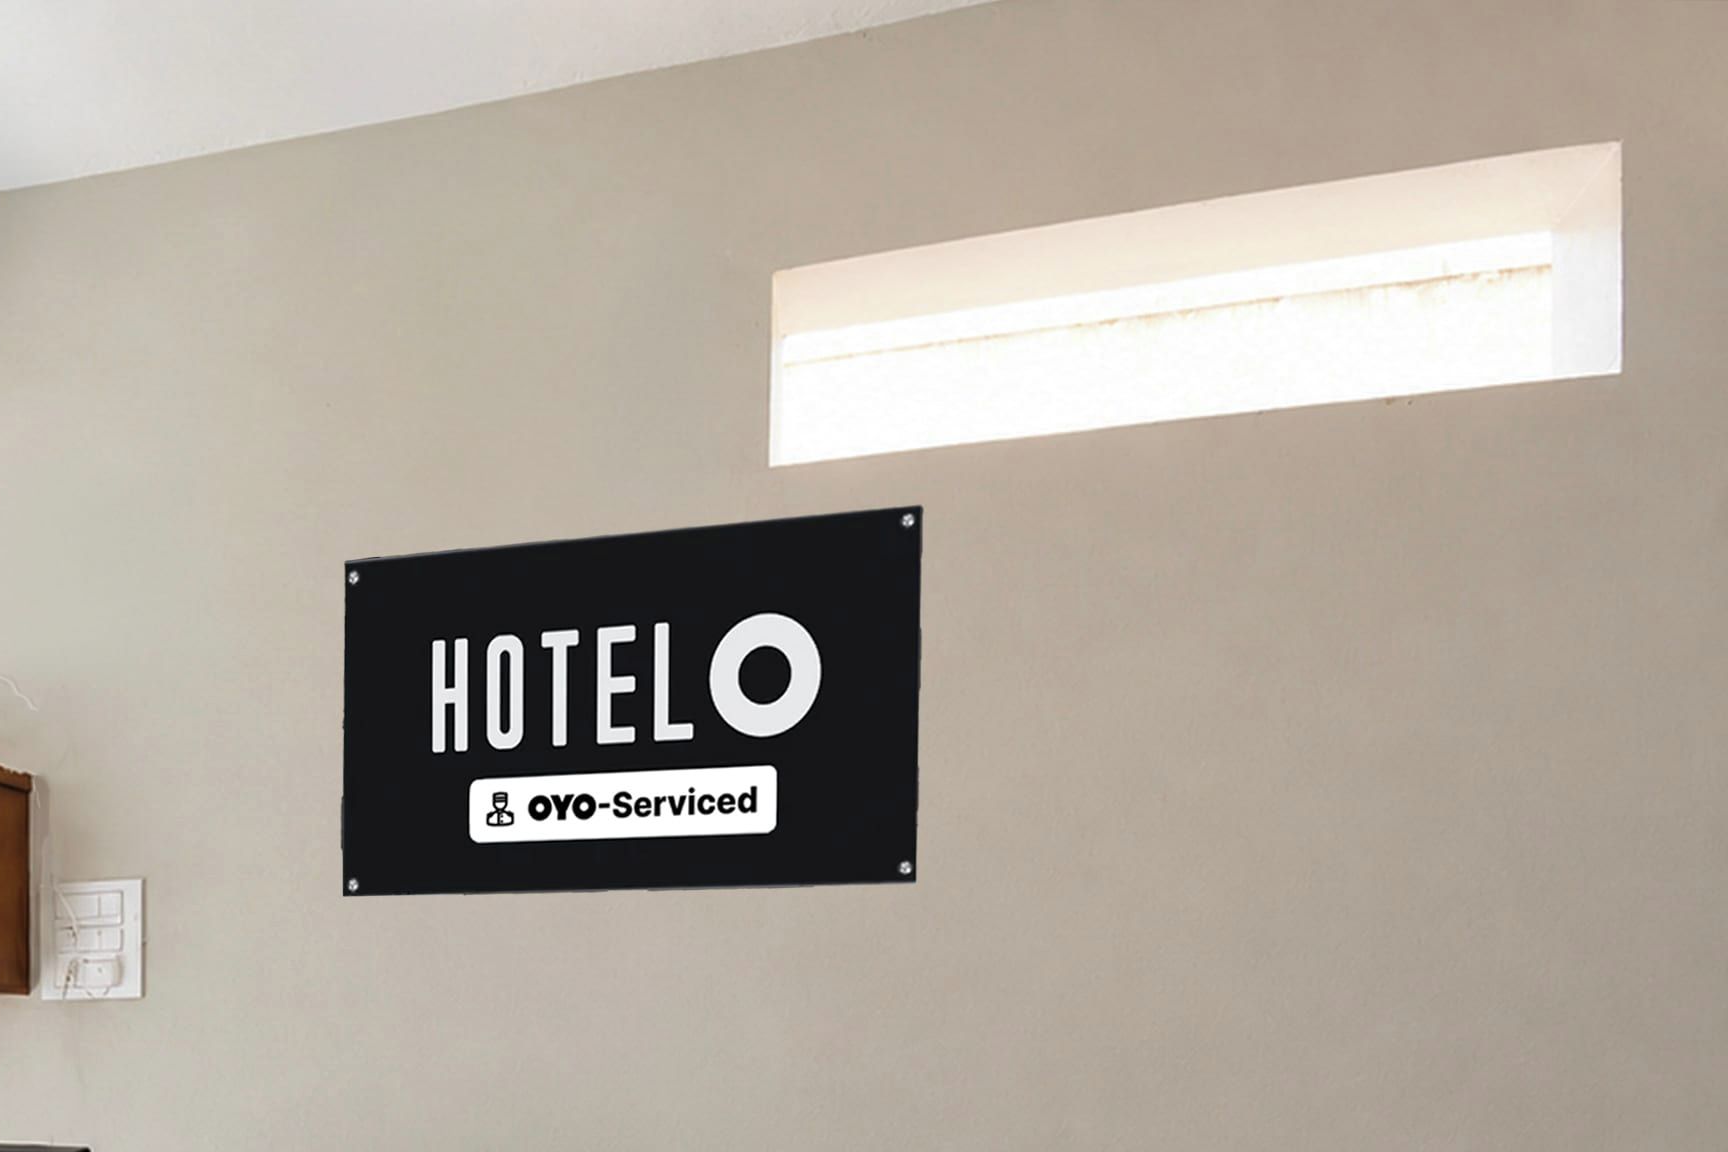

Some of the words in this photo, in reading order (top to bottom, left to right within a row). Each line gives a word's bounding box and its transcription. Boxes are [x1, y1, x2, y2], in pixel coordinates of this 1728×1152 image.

[431, 622, 694, 753] HOTEL
[709, 612, 822, 738] O
[527, 785, 758, 822] OYO-Serviced
